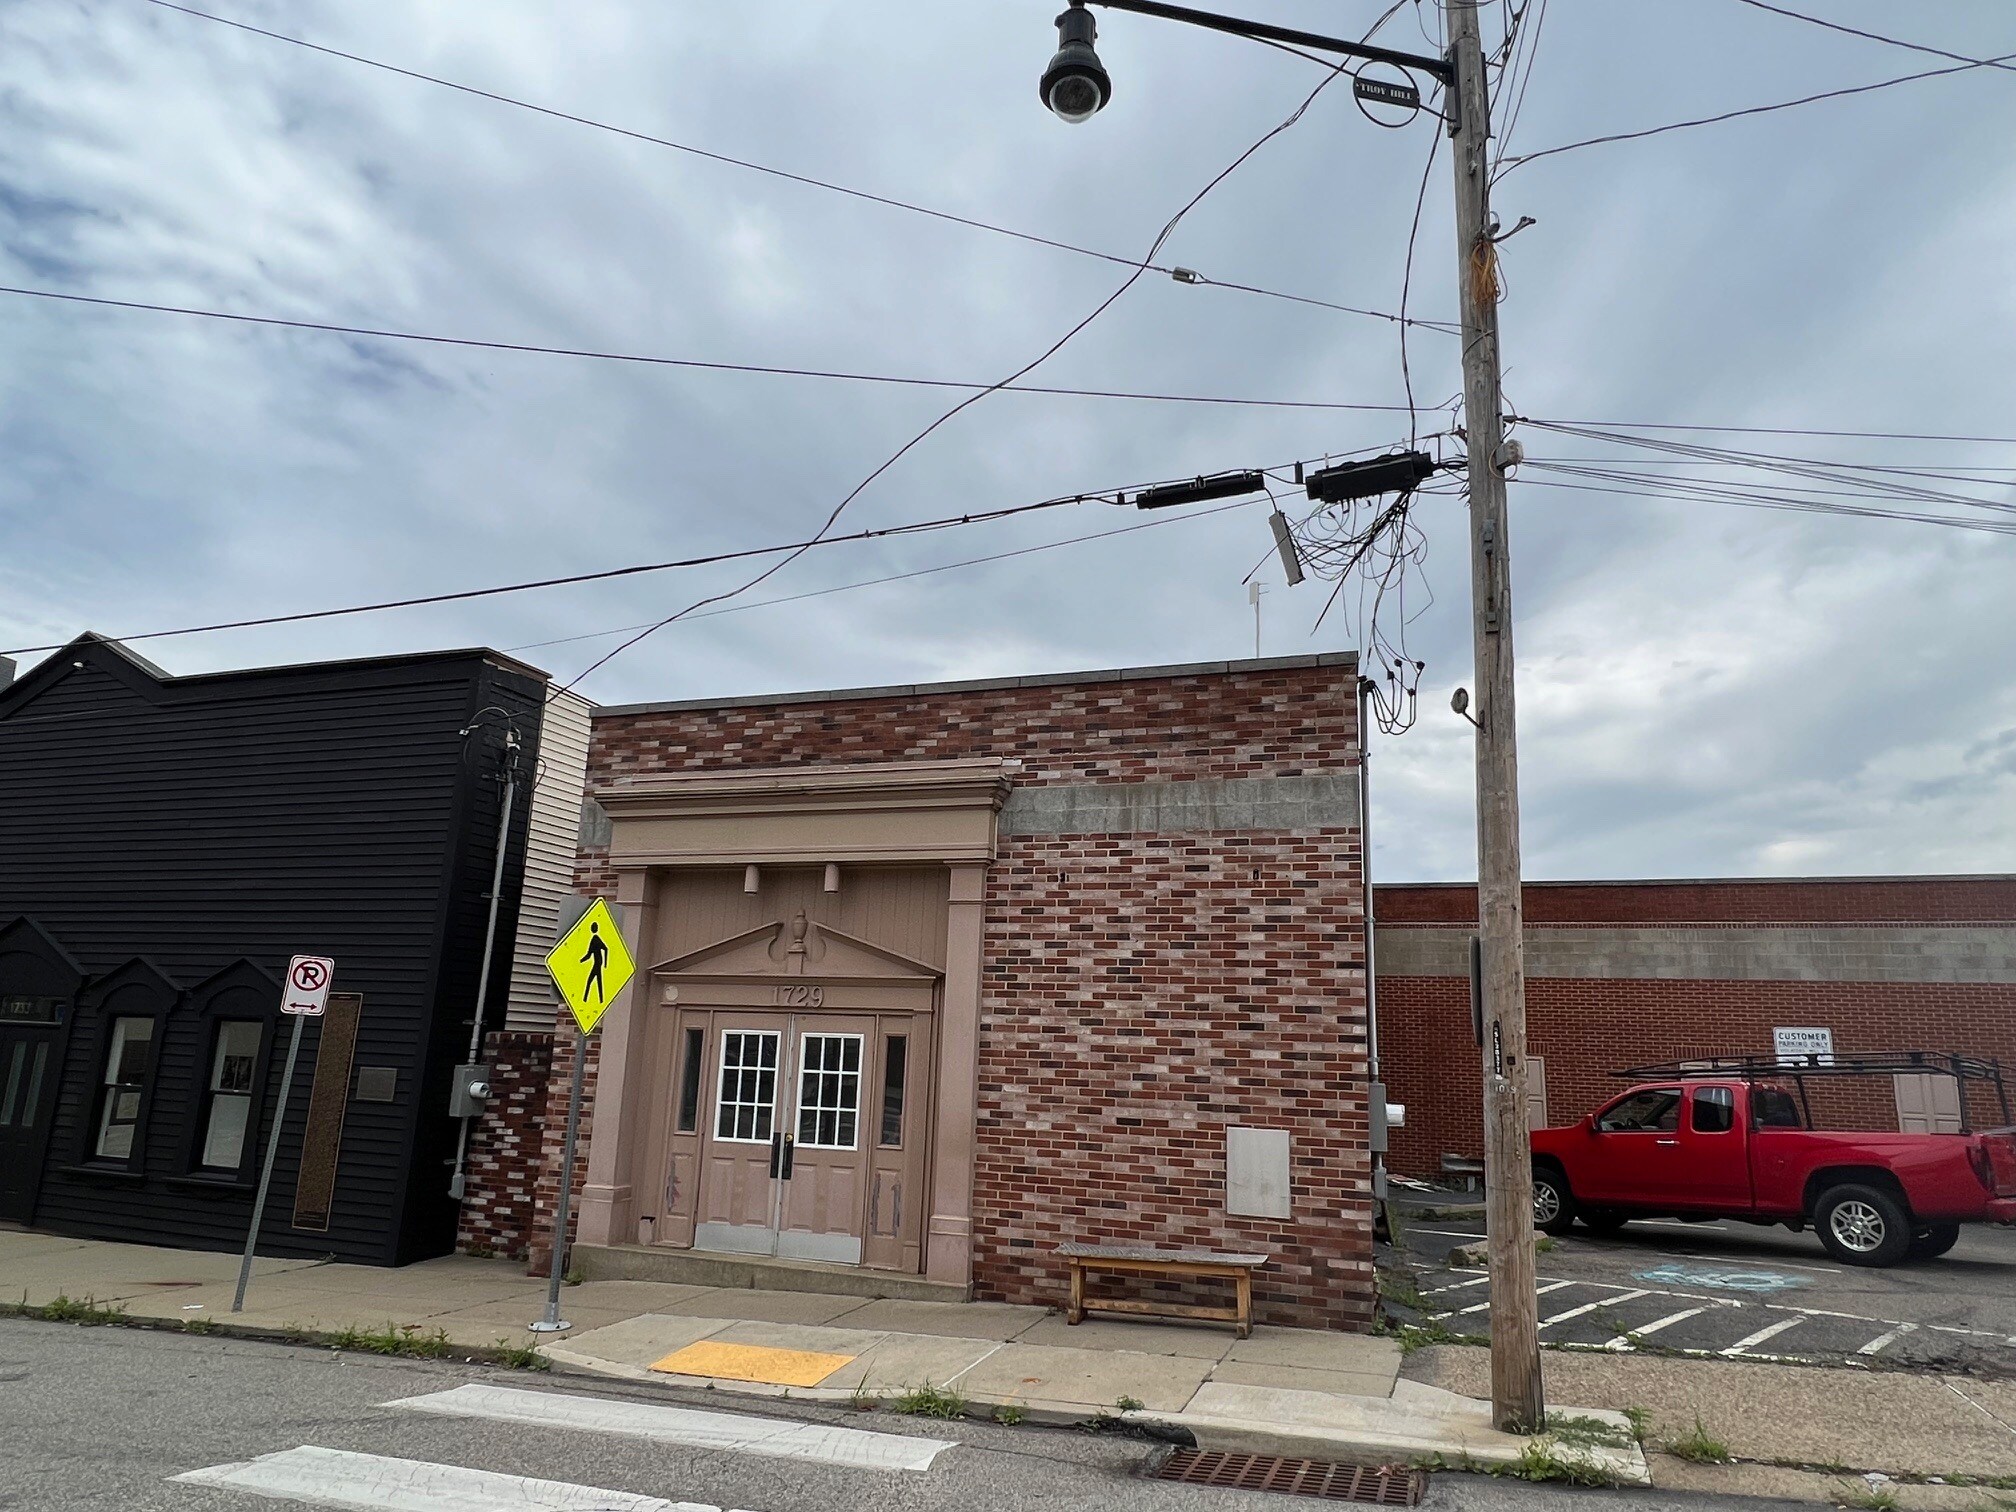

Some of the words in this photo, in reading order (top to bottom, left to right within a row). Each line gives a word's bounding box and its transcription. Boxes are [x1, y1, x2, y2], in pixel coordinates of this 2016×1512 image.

[1360, 83, 1386, 95] TROY
[1390, 89, 1412, 100] HILL
[773, 985, 824, 1008] 1729
[1778, 1032, 1827, 1041] CUSTOMER
